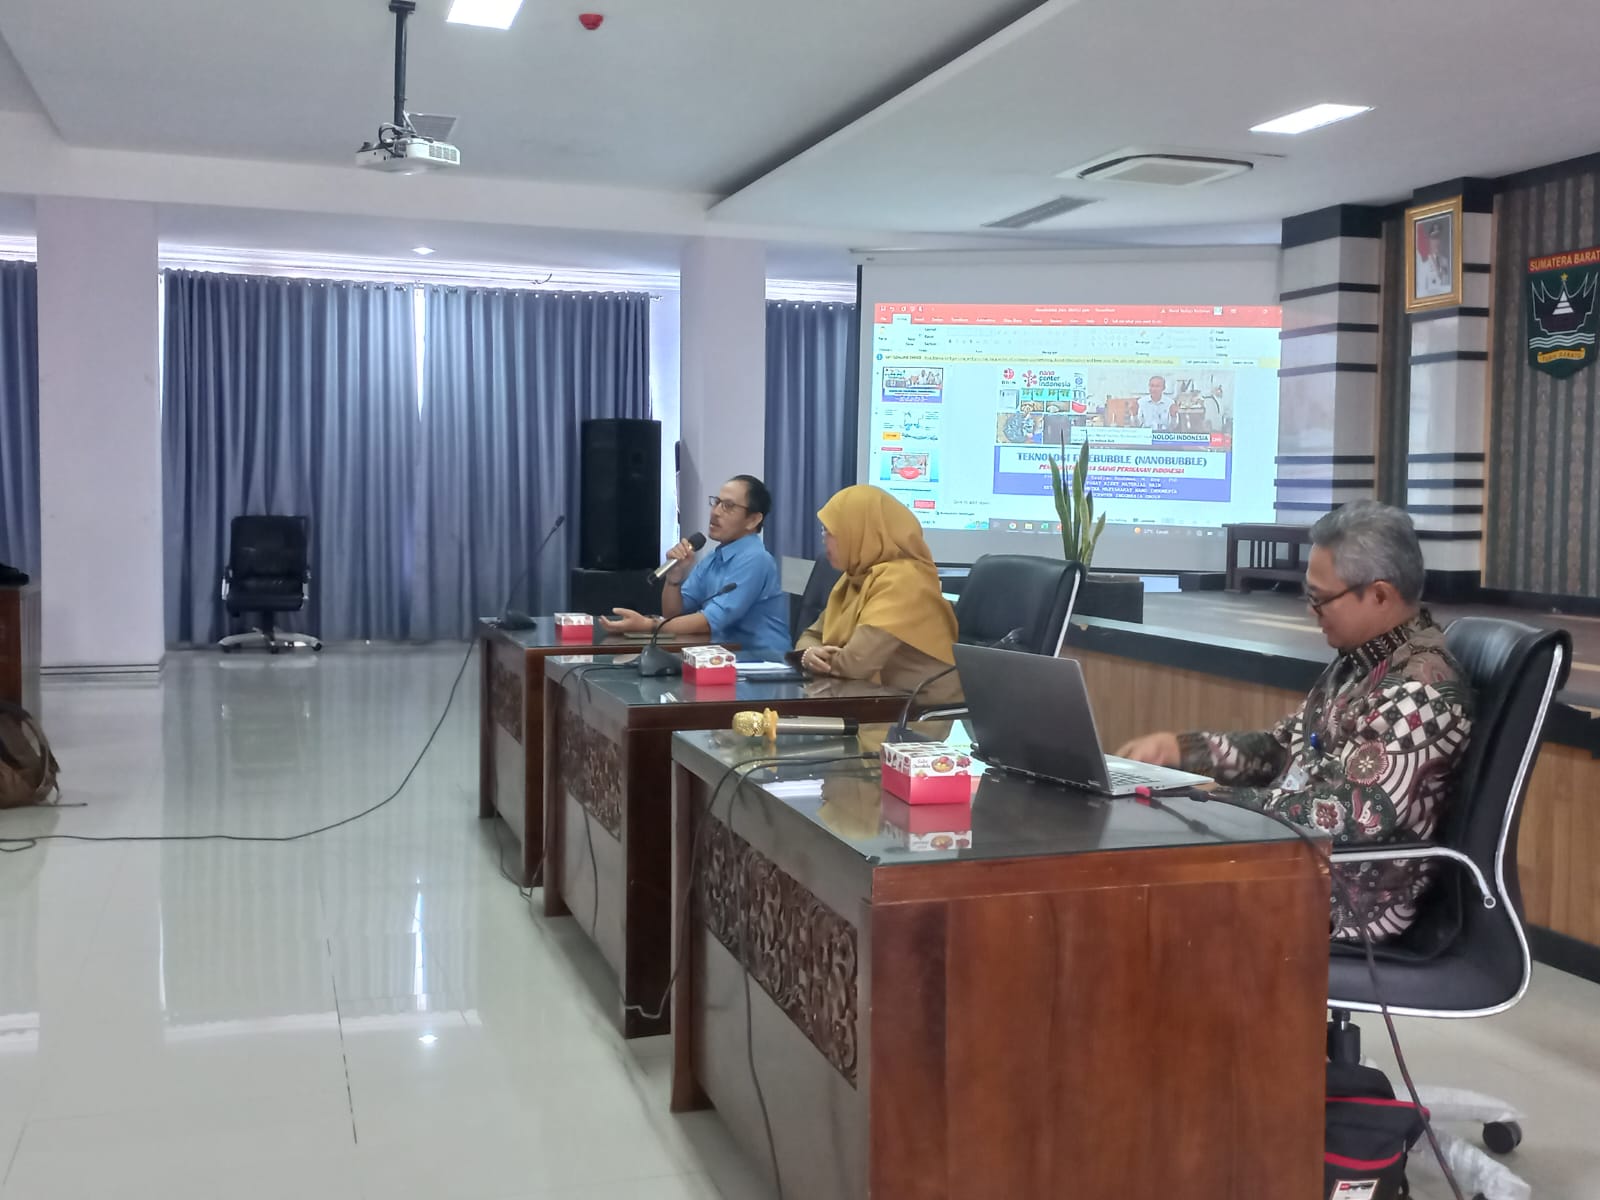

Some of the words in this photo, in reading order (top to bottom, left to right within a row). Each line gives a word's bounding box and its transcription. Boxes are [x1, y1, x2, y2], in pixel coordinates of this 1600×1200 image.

[1529, 255, 1573, 271] SUMATERA
[1573, 250, 1600, 265] BARAT
[1016, 452, 1072, 463] TEKNOOI
[1134, 455, 1207, 467] (NANOBUBBLE)
